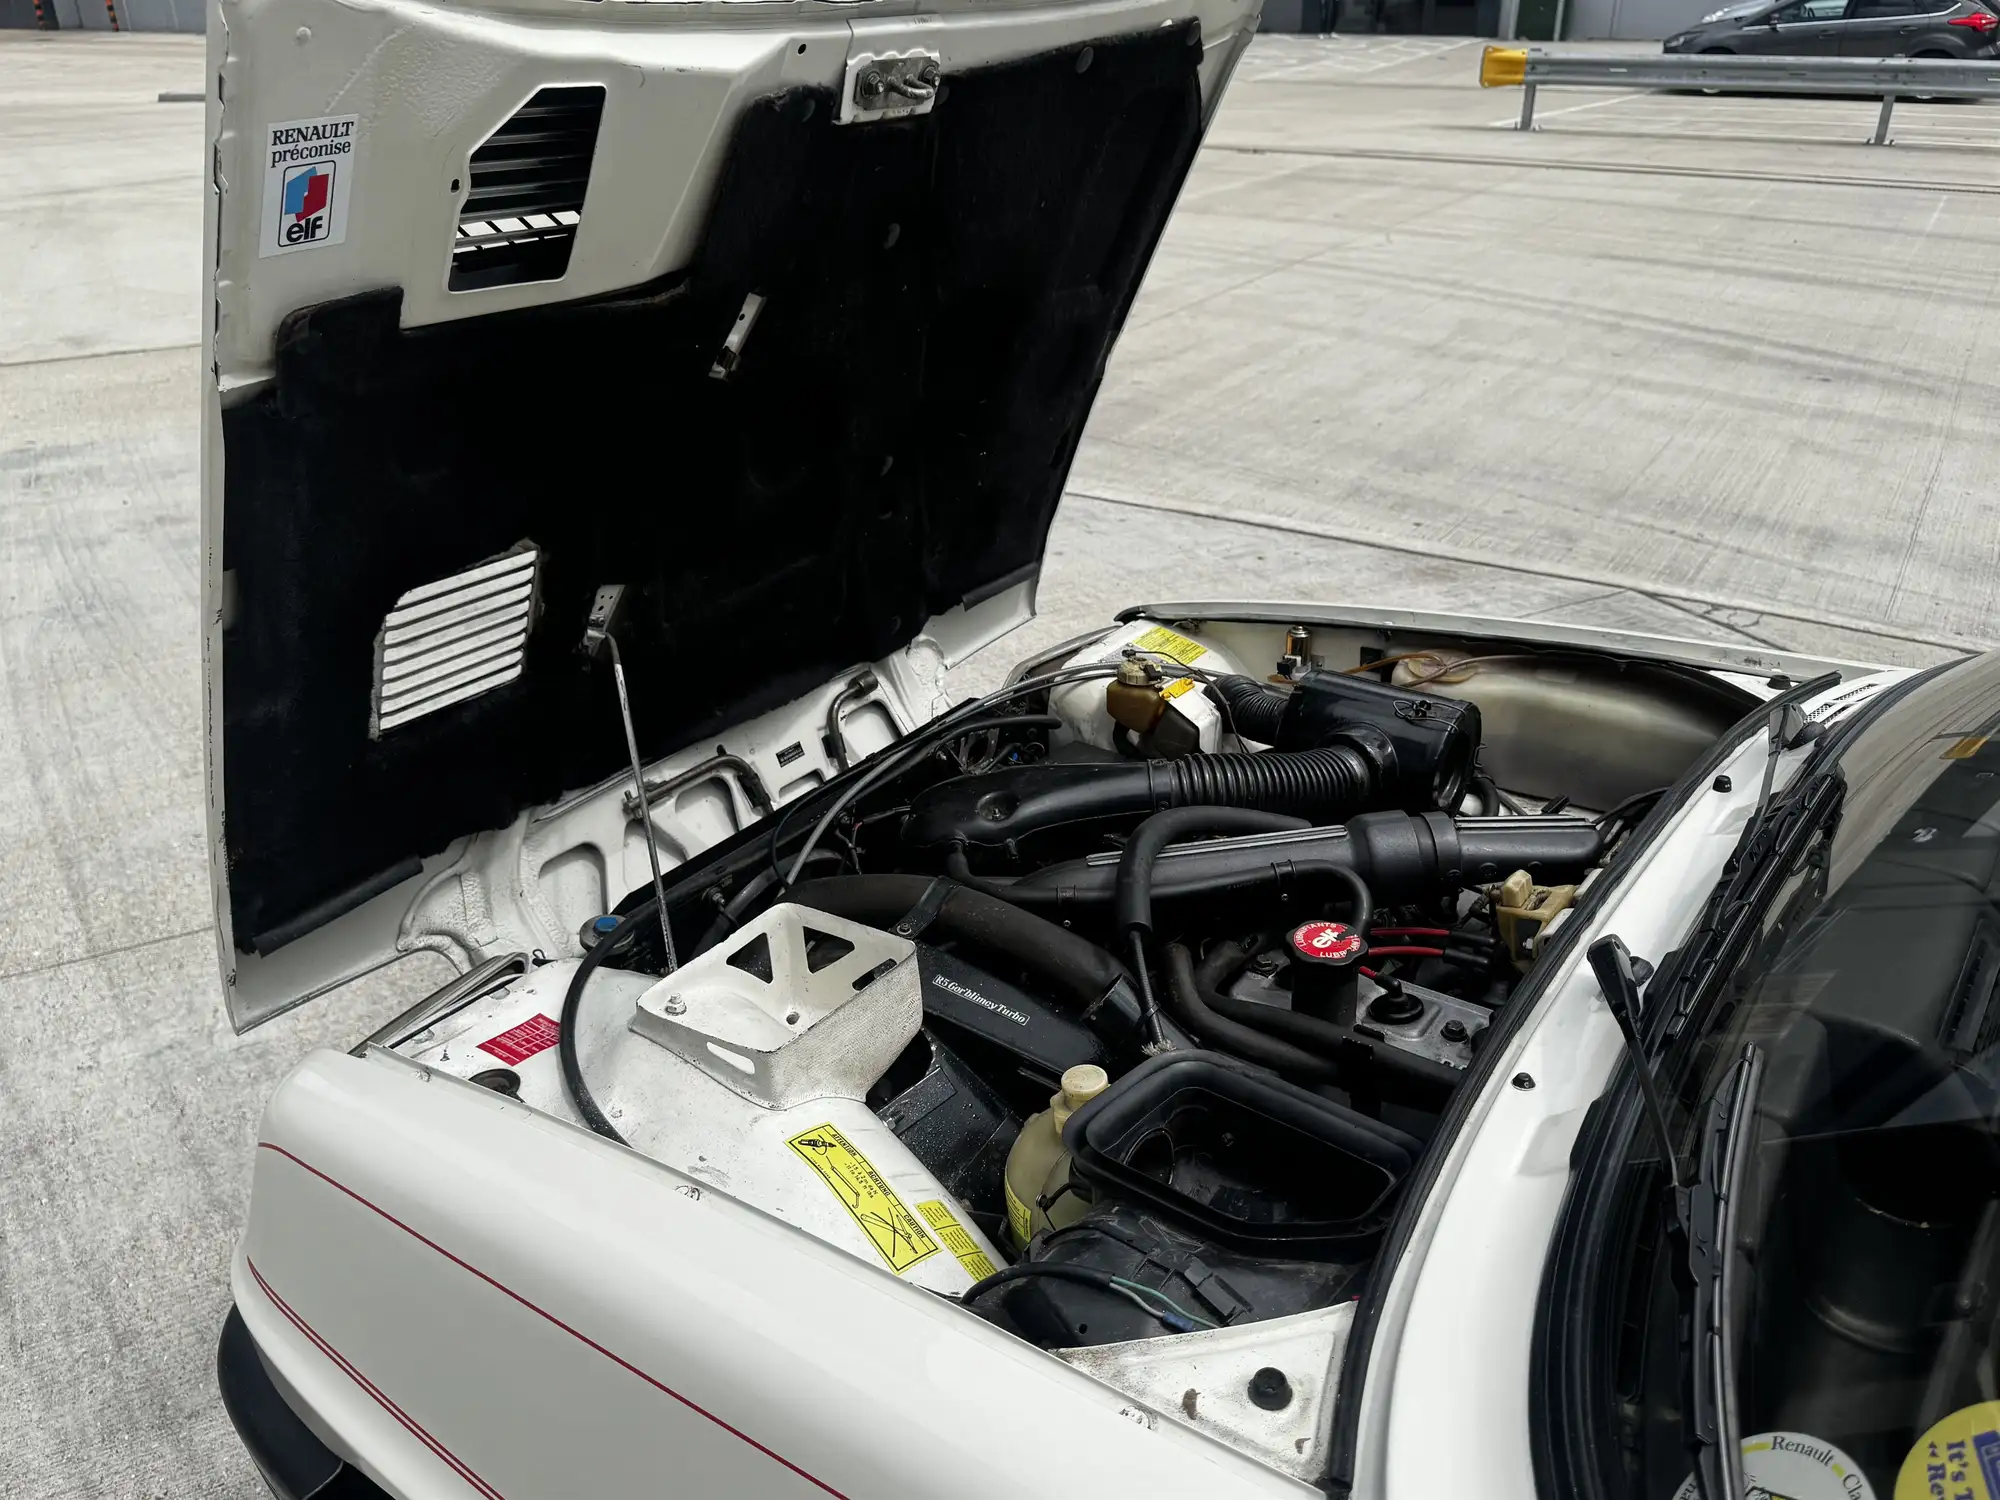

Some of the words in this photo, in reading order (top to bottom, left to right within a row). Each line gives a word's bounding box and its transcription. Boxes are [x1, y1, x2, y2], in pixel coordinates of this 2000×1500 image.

[271, 121, 355, 146] RENAULT
[270, 140, 351, 168] préconise
[286, 215, 323, 242] elf
[935, 975, 950, 987] R5
[996, 1003, 1026, 1023] Turbo
[831, 1133, 858, 1157] ATTENTION
[868, 1171, 891, 1196] ACHTUNG
[903, 1214, 926, 1239] CAUTION
[1771, 1435, 1834, 1467] Renault
[1946, 1439, 1969, 1482] It's
